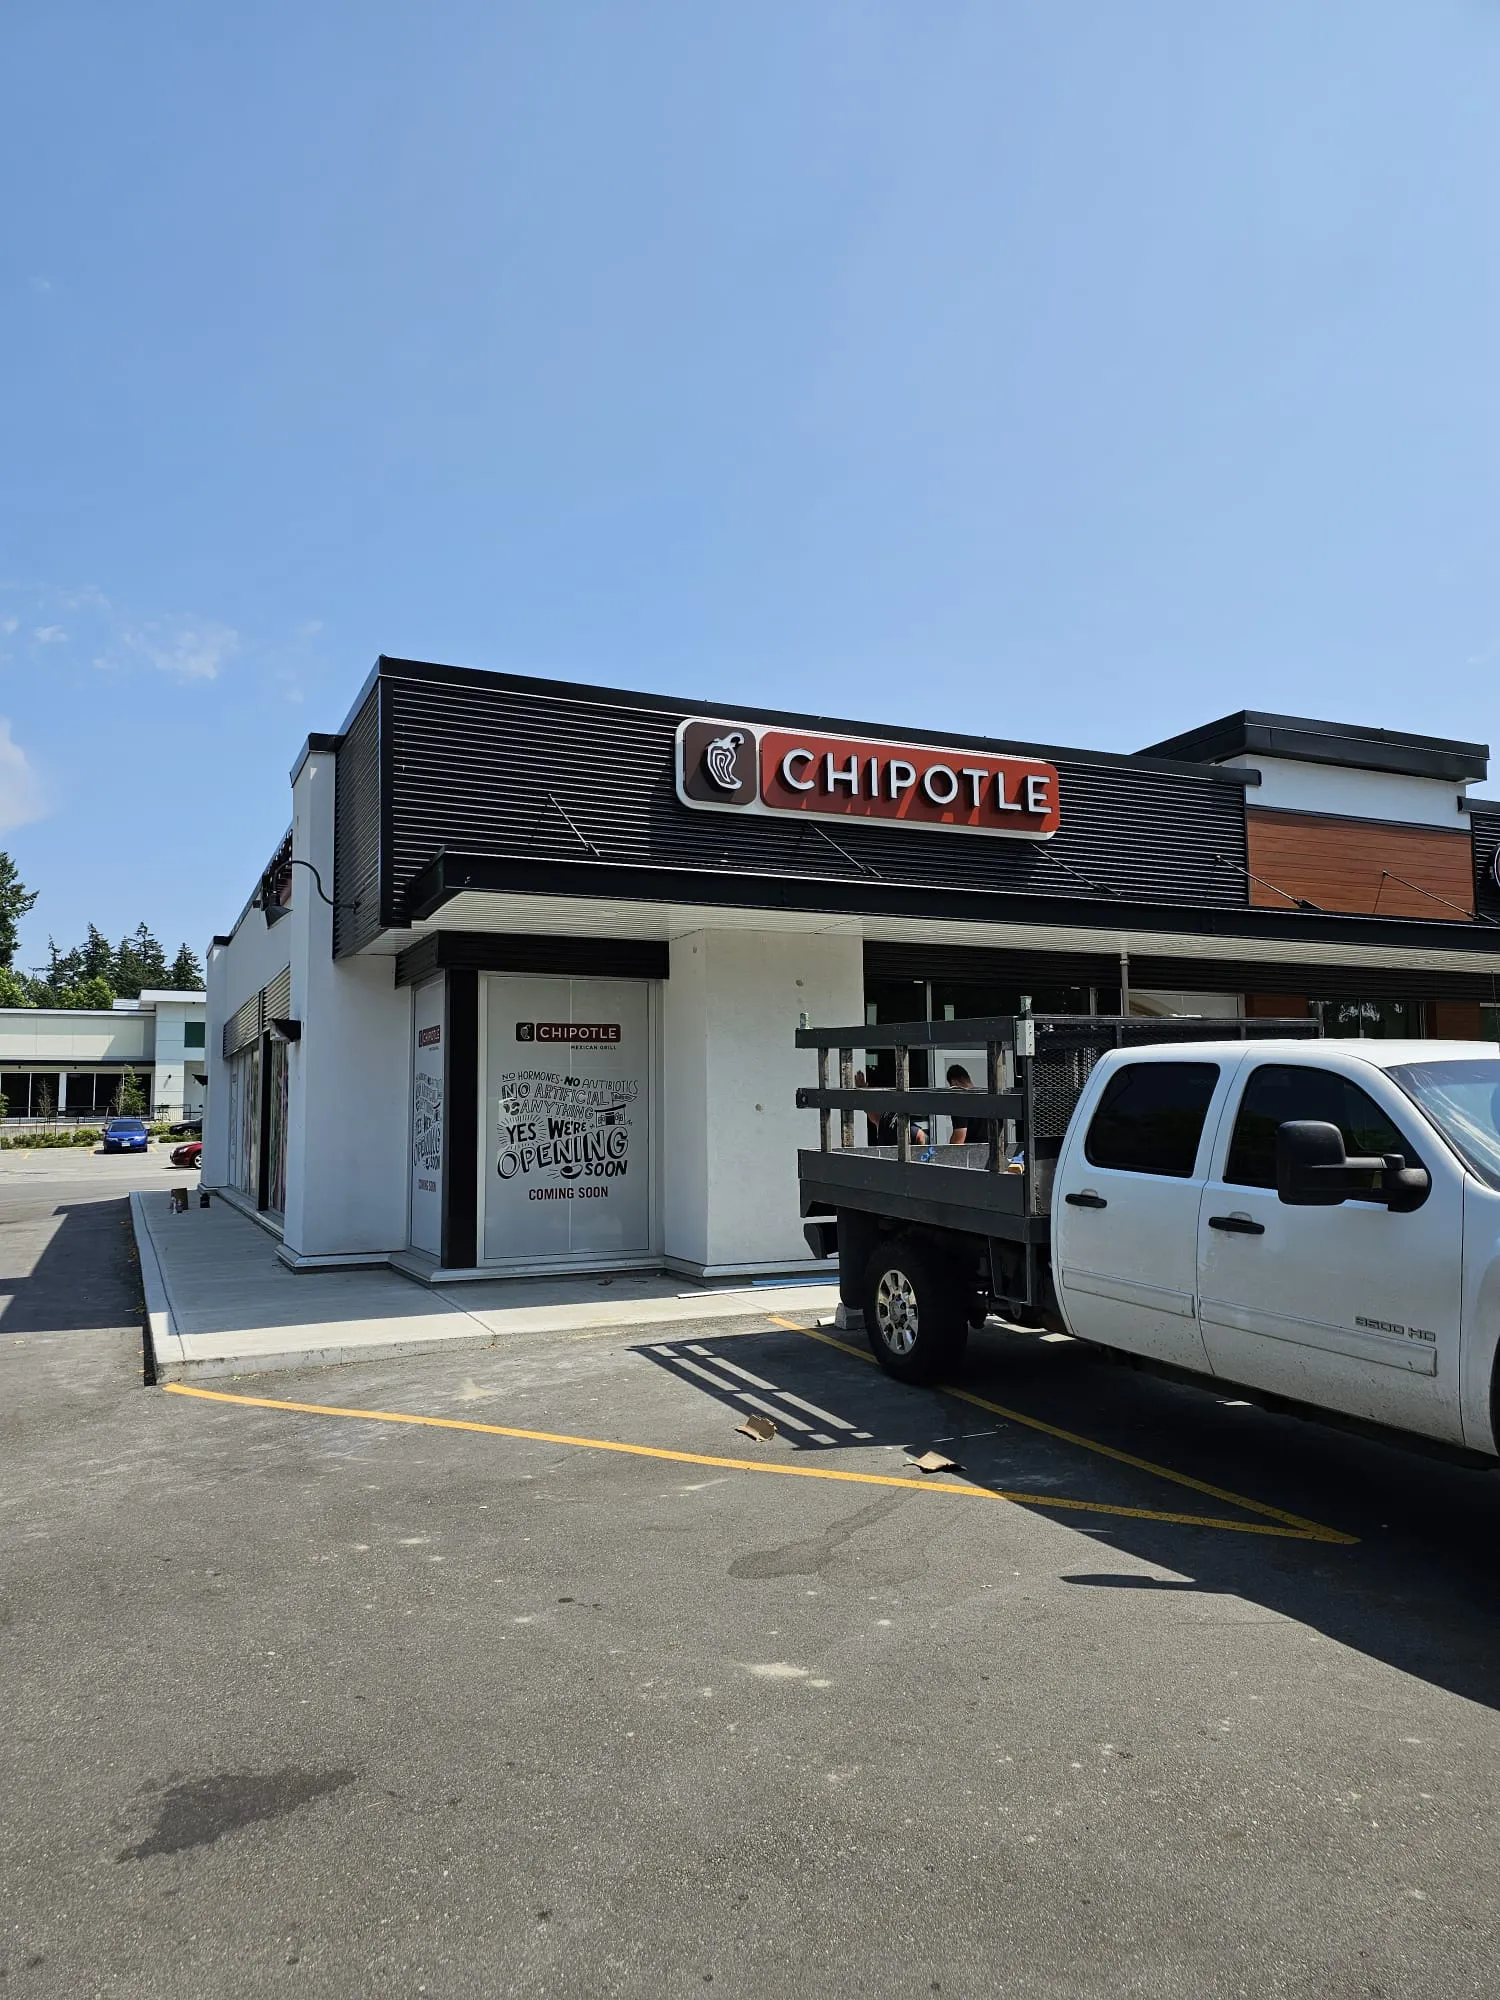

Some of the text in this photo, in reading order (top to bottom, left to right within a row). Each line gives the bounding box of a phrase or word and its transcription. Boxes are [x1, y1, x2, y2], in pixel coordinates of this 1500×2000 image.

[782, 748, 1053, 814] CHIPOTLE
[540, 1026, 617, 1039] CHIPOTLE
[502, 1072, 516, 1081] NO
[564, 1076, 580, 1087] NO
[582, 1079, 639, 1094] ANTIBIOTICS
[502, 1082, 609, 1106] NO ARTIFICIAL
[520, 1100, 594, 1120] ANYTHING
[506, 1117, 587, 1144] YES WE'RE
[497, 1127, 628, 1179] OPENING
[584, 1160, 628, 1177] SOON
[529, 1186, 608, 1200] COMING SOON
